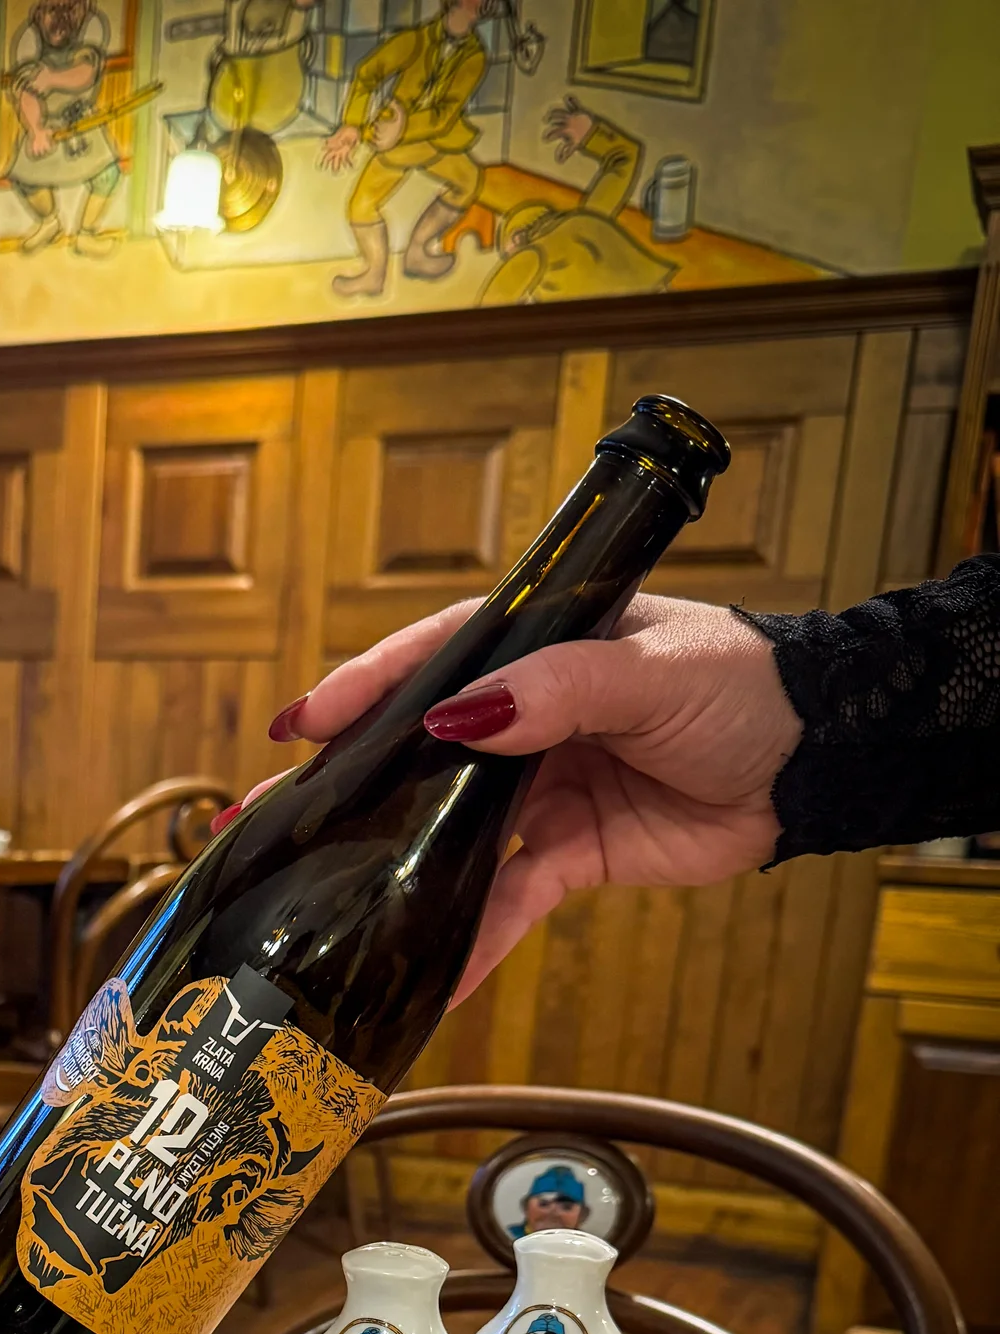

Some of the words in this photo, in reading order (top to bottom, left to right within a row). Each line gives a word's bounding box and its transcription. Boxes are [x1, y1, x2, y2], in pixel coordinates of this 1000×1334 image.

[192, 1050, 226, 1082] KRÁVA
[202, 1036, 236, 1068] ZLATÁ
[129, 1079, 209, 1168] 12
[75, 1179, 160, 1258] TUČNÁ
[96, 1140, 188, 1224] PLNO
